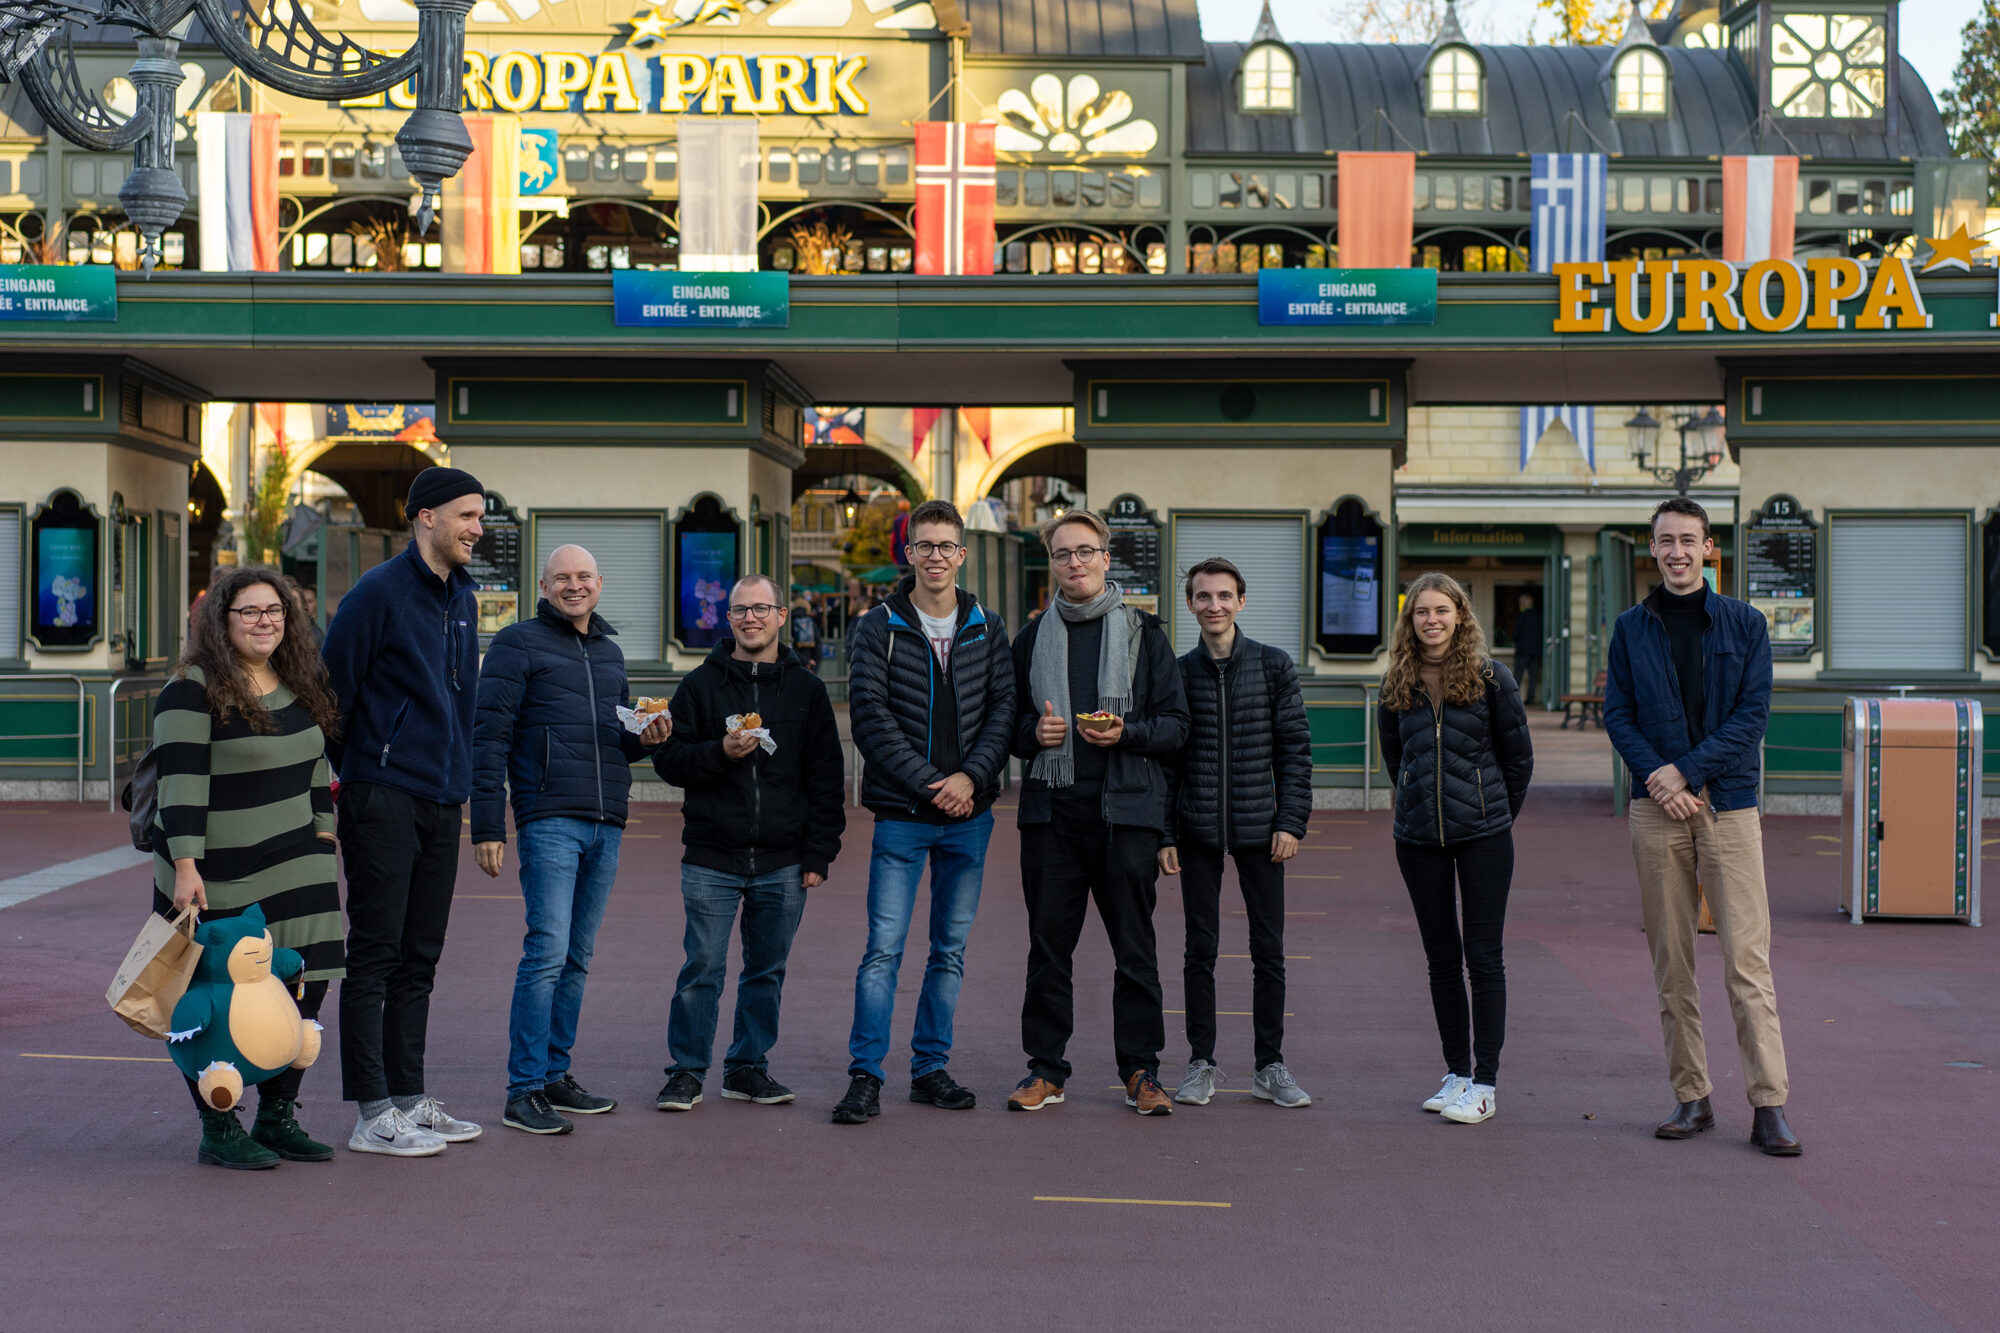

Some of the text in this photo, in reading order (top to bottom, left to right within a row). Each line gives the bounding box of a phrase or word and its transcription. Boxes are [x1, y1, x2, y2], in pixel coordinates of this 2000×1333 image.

[659, 53, 869, 114] PARK
[672, 285, 730, 300] EINGANG
[1318, 283, 1377, 297] EINGANG
[1552, 258, 1933, 333] EUROPA
[24, 298, 88, 311] ENTRANCE
[642, 302, 688, 317] ENTRÉE
[698, 305, 761, 318] ENTRANCE
[1288, 300, 1334, 315] ENTRÉE
[1344, 302, 1407, 315] ENTRANCE
[1120, 501, 1136, 514] 13
[1773, 501, 1790, 515] 15
[1433, 529, 1525, 544] Information
